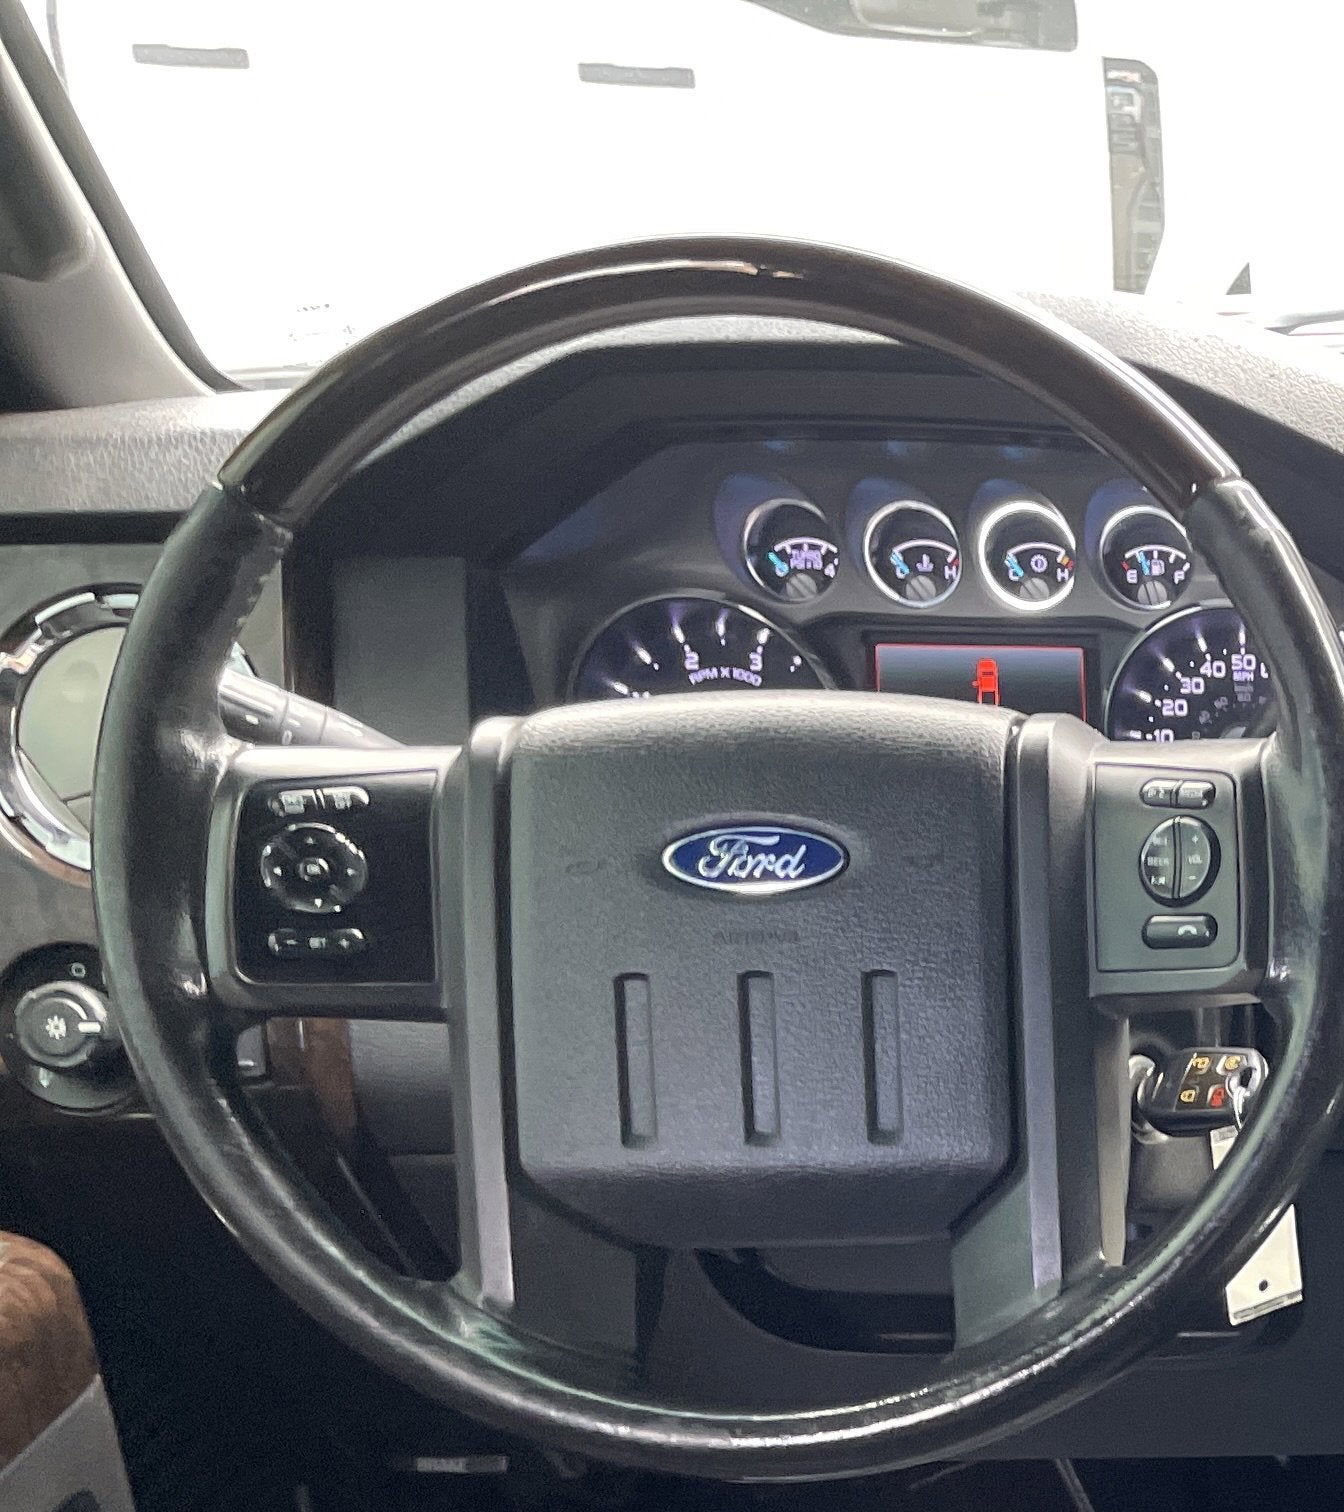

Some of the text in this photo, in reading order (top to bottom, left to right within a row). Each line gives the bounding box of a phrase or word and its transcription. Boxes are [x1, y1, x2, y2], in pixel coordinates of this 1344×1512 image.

[944, 566, 957, 582] H
[1057, 568, 1069, 582] H
[1126, 569, 1138, 584] E
[1174, 570, 1185, 584] F
[684, 651, 699, 671] 2
[749, 652, 763, 671] 3
[1200, 660, 1226, 678] 40
[1231, 653, 1256, 671] 50
[688, 667, 718, 686] RPM
[732, 667, 763, 688] 1000
[1180, 676, 1205, 695] 30
[1233, 671, 1254, 682] MPH
[1162, 698, 1188, 717] 20
[1153, 729, 1174, 743] 10
[698, 835, 806, 879] Ford
